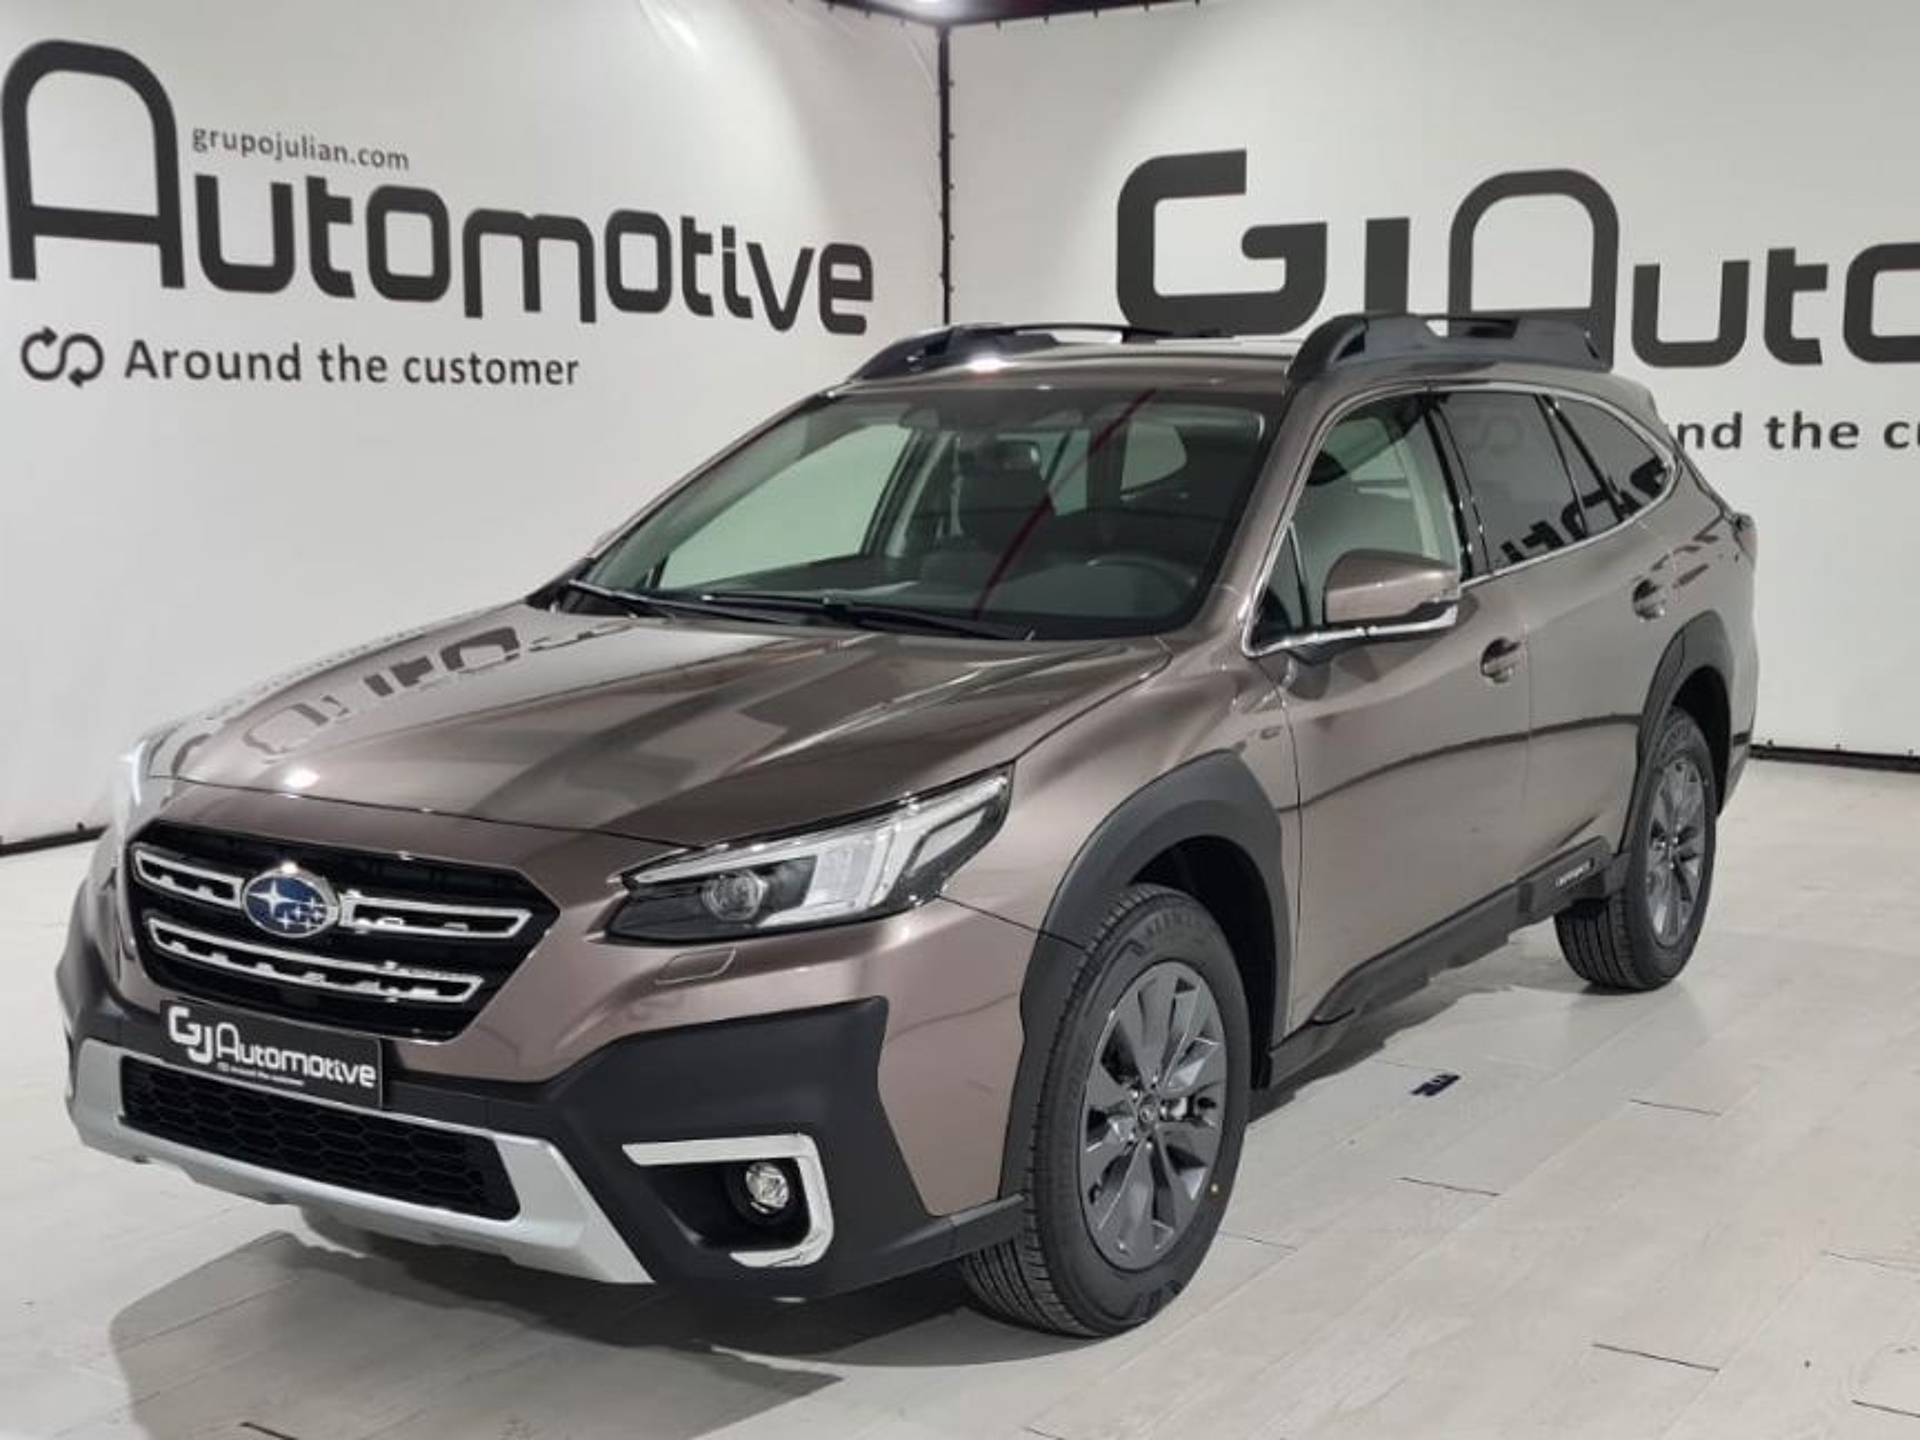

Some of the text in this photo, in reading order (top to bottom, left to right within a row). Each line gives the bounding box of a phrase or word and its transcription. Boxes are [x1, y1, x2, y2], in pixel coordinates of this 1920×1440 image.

[192, 128, 410, 171] grupojulian.com
[1, 39, 874, 336] Automotive
[125, 339, 580, 386] Around the customer
[1676, 410, 1920, 450] nd the c
